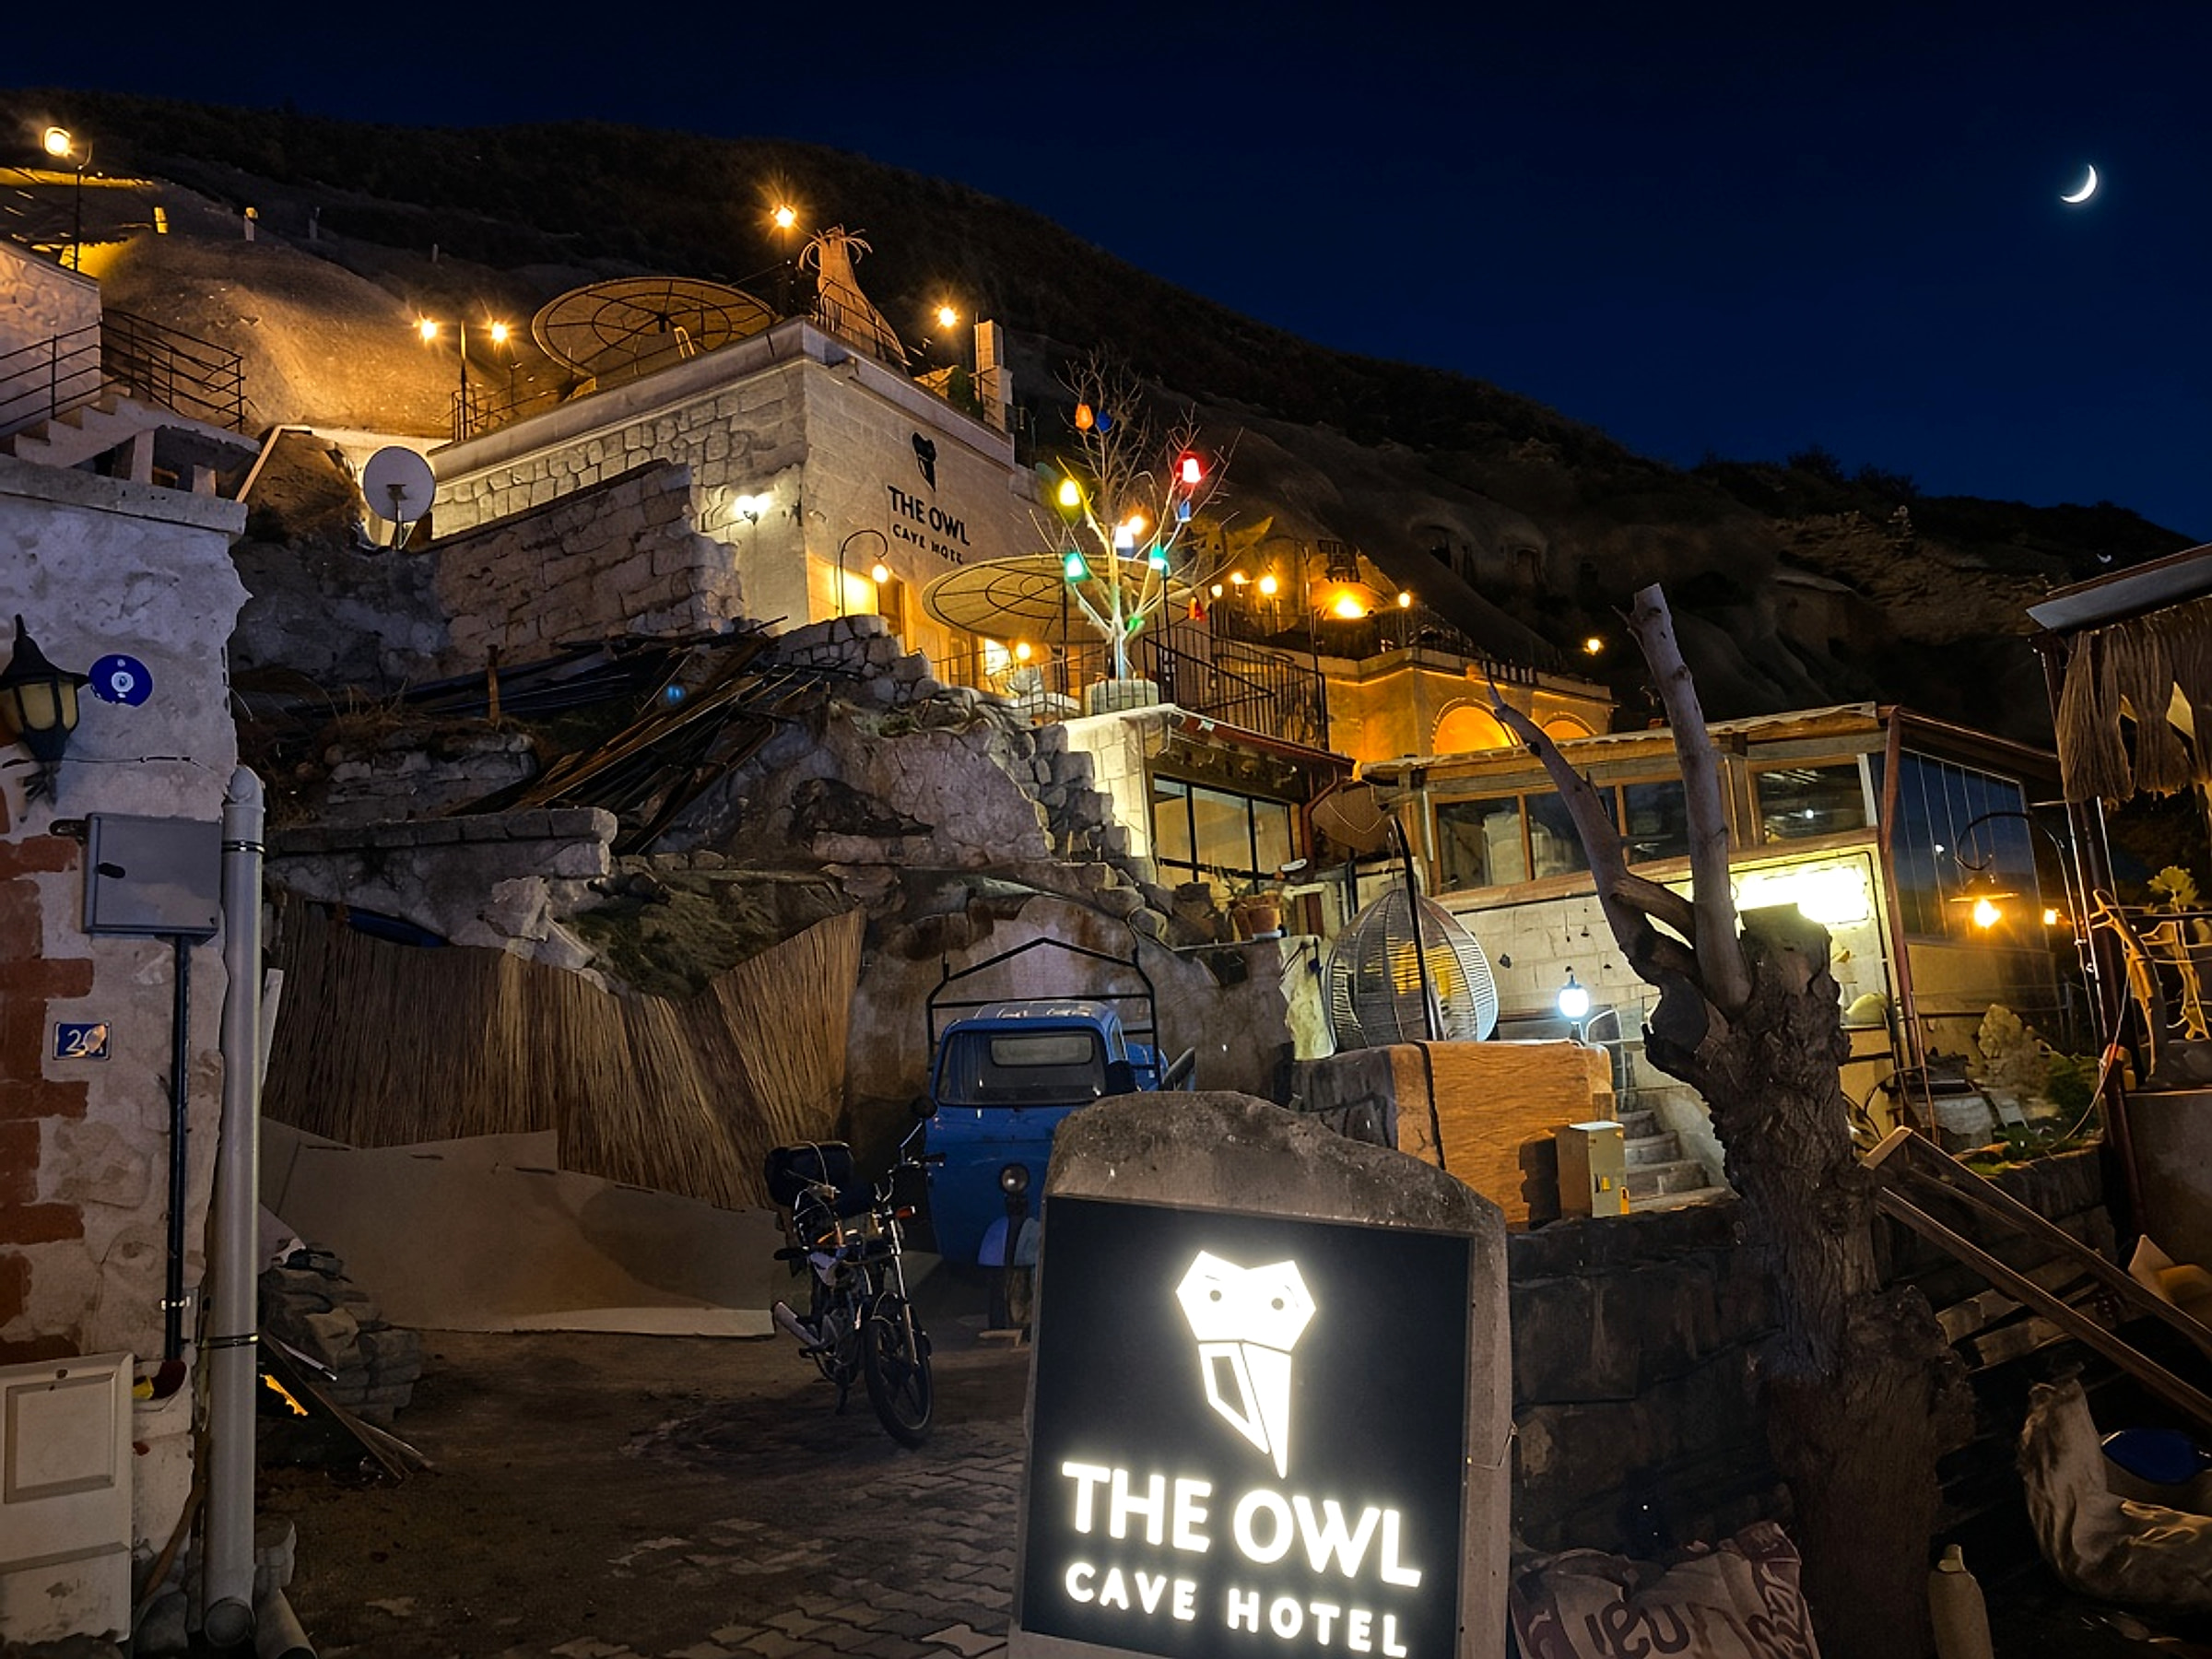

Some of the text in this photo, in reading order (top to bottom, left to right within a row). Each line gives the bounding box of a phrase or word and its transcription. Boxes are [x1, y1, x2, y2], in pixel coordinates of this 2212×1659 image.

[887, 484, 971, 547] THE OWL
[1062, 1461, 1421, 1588] THE OWL
[1065, 1562, 1407, 1658] CAVE HOTEL
